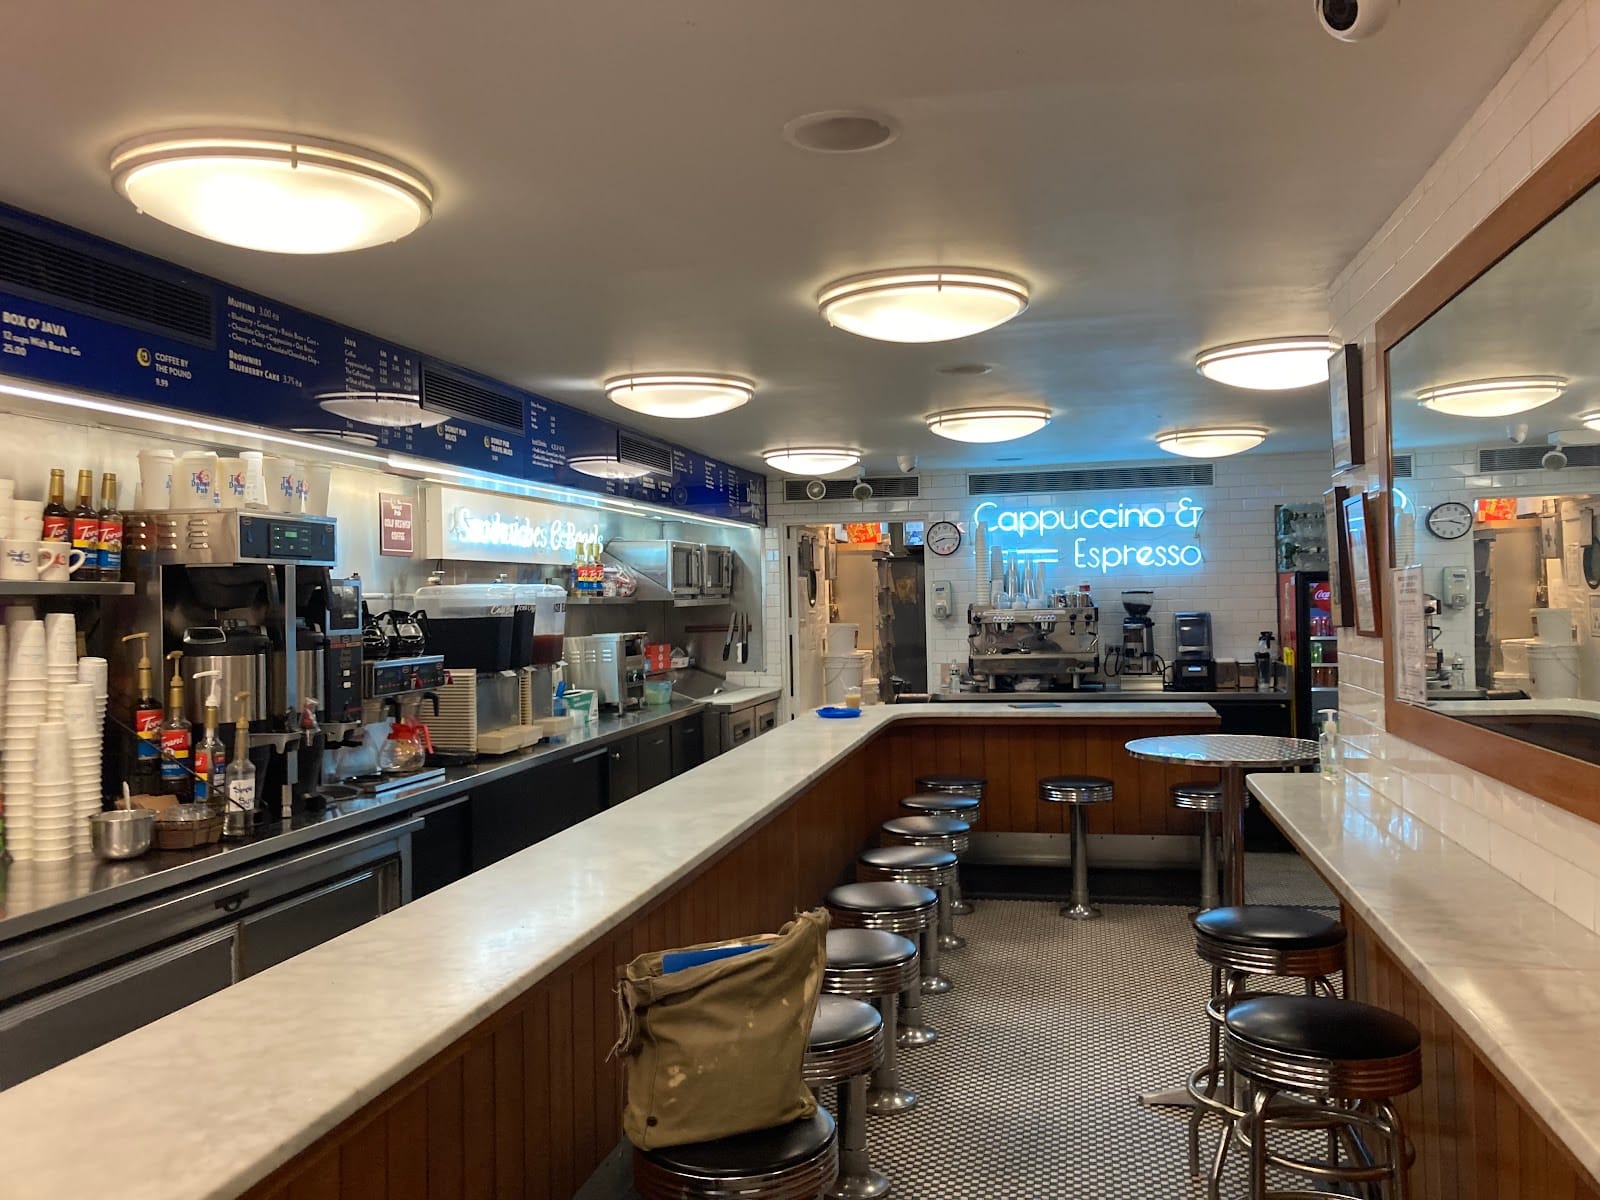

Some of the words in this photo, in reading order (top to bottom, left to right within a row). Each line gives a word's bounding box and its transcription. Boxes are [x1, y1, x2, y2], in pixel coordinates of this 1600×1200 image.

[2, 311, 27, 328] BOX
[41, 320, 68, 338] JAVA
[154, 352, 180, 366] COFFEE
[180, 358, 189, 368] BY
[228, 349, 262, 367] BROWNIES
[155, 363, 169, 375] THE
[169, 366, 192, 380] POUND
[974, 502, 1165, 538] Cappuccino
[1174, 497, 1203, 529] &
[1074, 538, 1203, 574] Espresso
